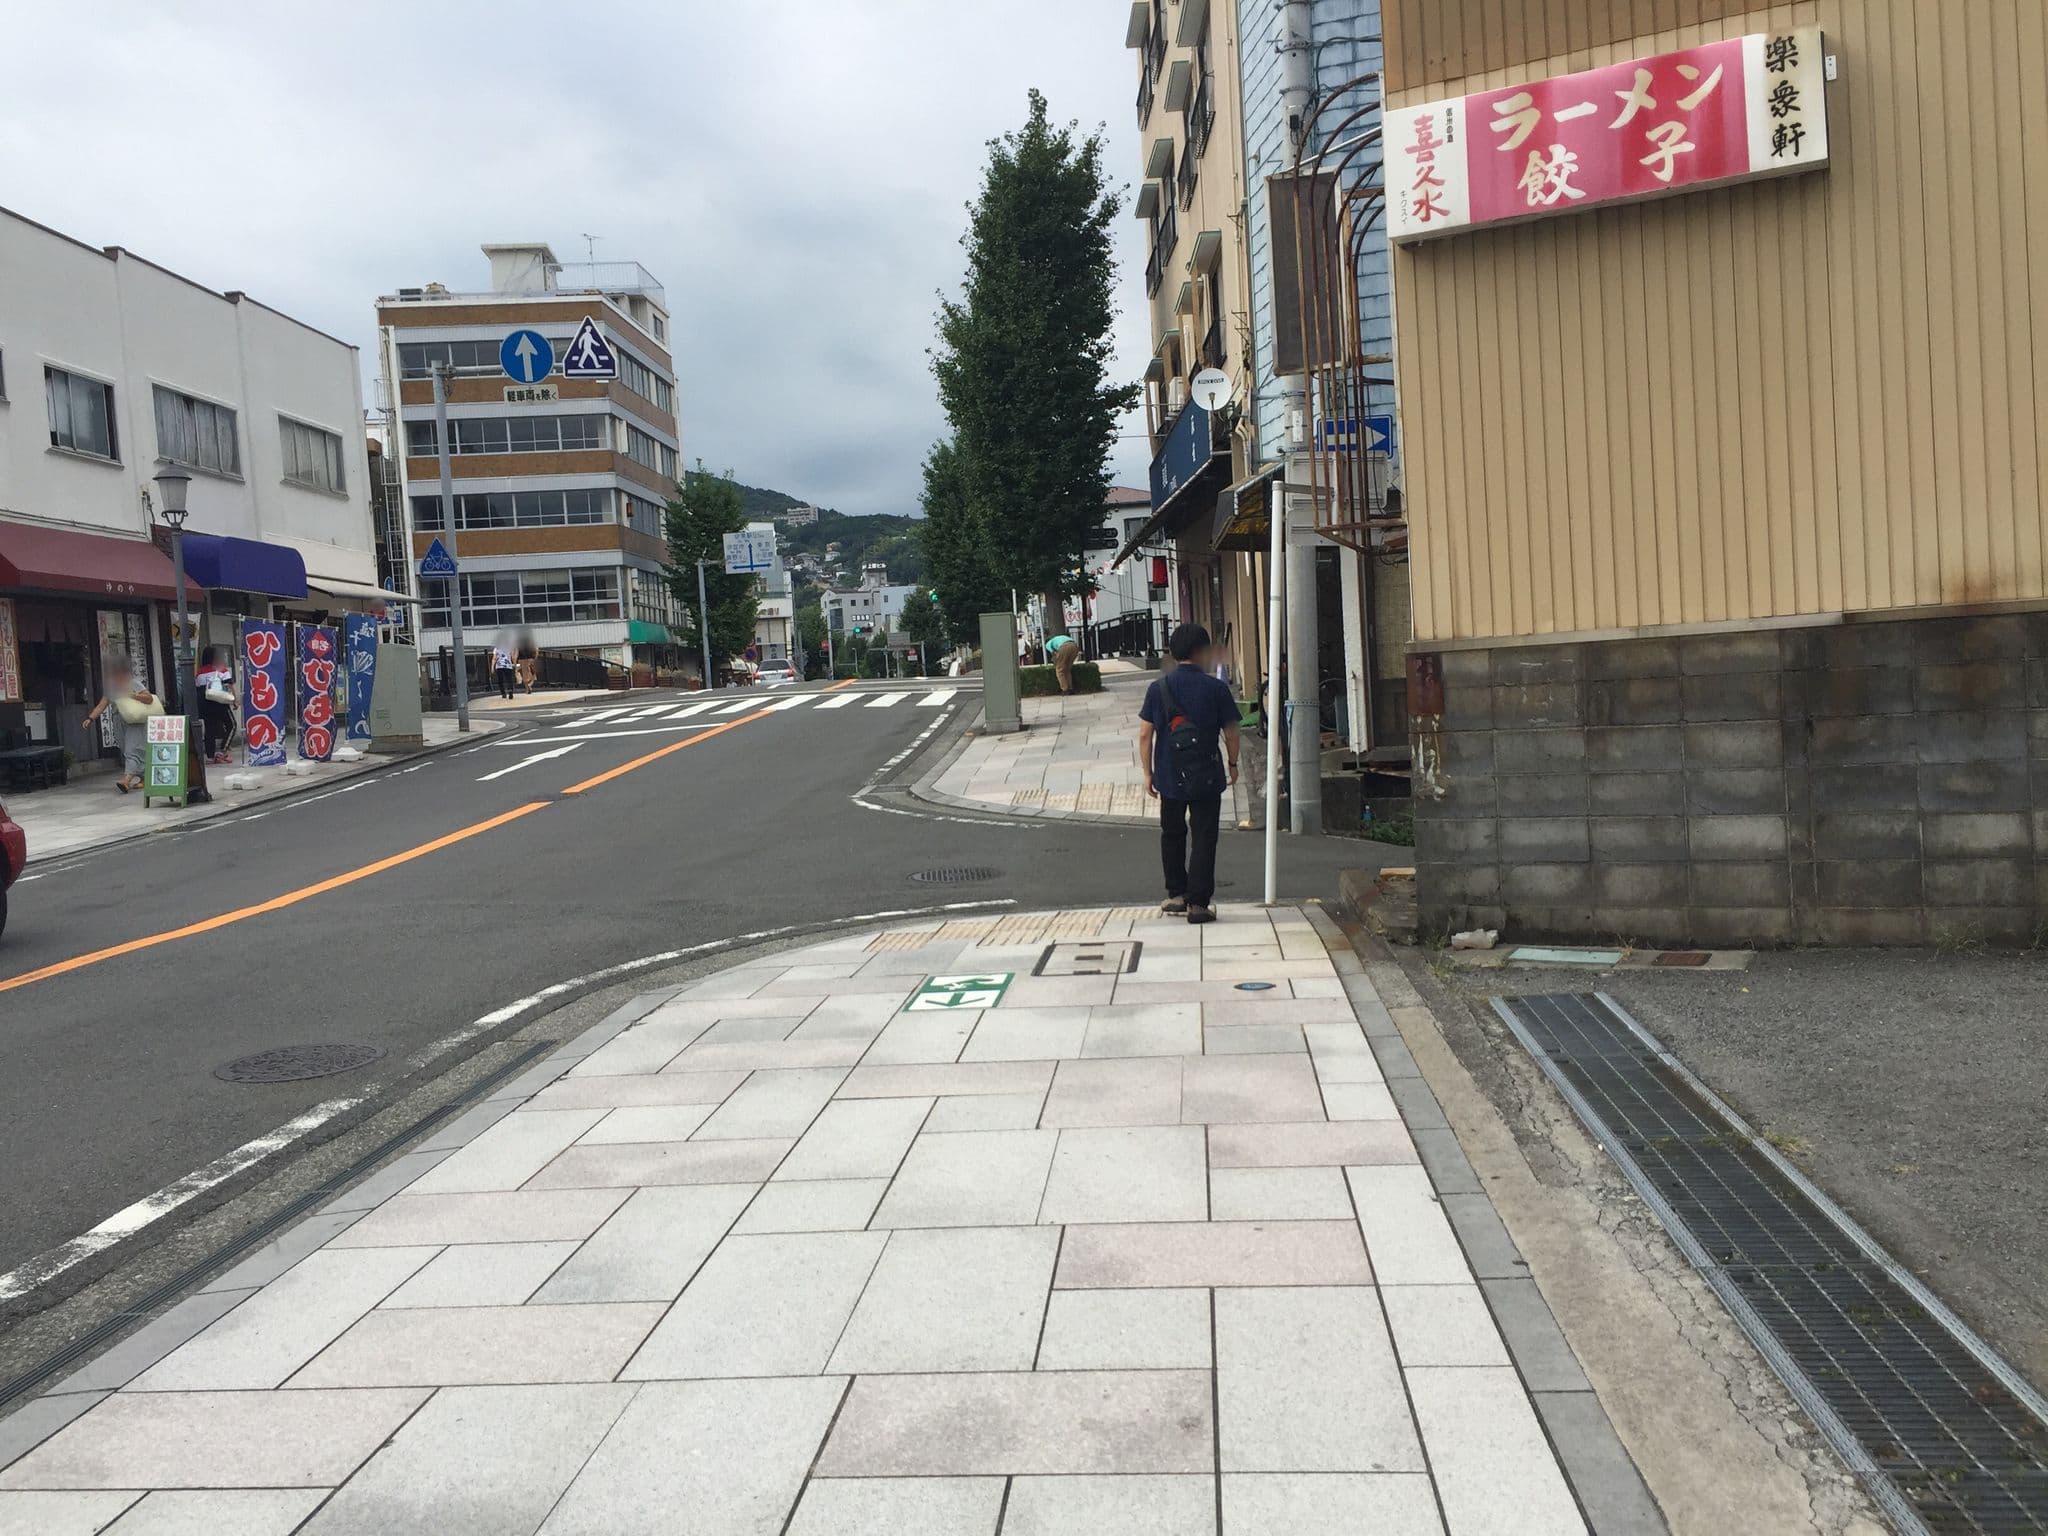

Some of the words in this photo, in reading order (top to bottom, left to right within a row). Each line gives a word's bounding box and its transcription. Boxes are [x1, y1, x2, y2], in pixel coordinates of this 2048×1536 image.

[1489, 62, 1725, 152] ラーメン
[1399, 191, 1408, 224] キクスイ
[1404, 113, 1450, 222] 喜久水
[1516, 120, 1696, 206] 餃子
[507, 389, 557, 402] 軽車両を除く
[246, 630, 281, 751] ひもの
[302, 658, 335, 758] ひもの
